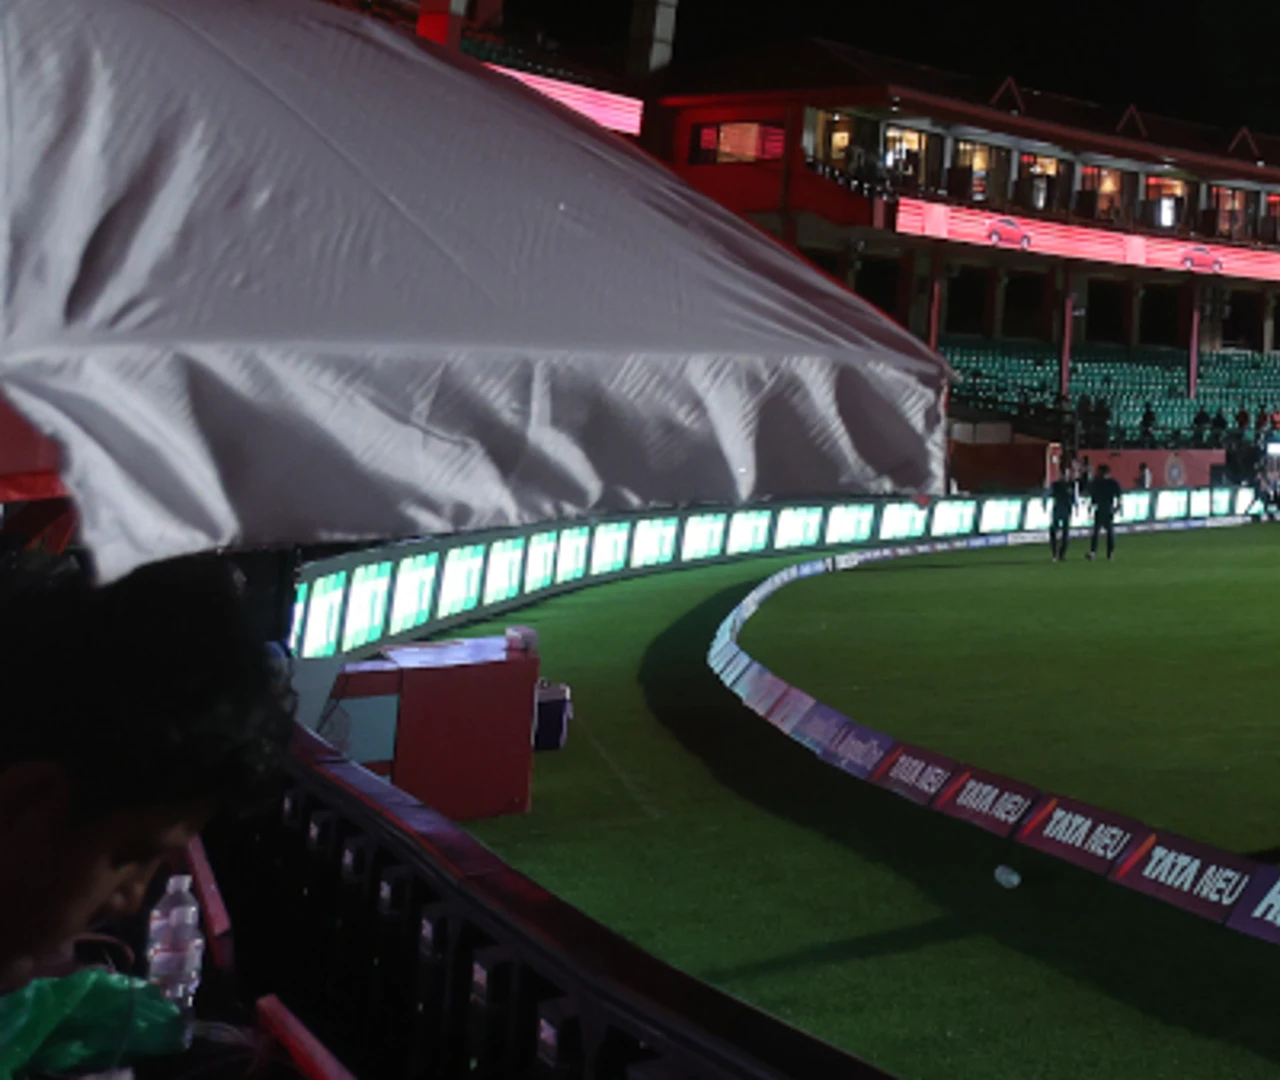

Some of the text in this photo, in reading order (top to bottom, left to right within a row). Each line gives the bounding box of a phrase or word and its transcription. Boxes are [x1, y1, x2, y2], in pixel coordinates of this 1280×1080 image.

[956, 778, 1033, 825] TATA NEU
[1042, 806, 1133, 861] TATA NEU
[1142, 845, 1250, 916] TATA NEU
